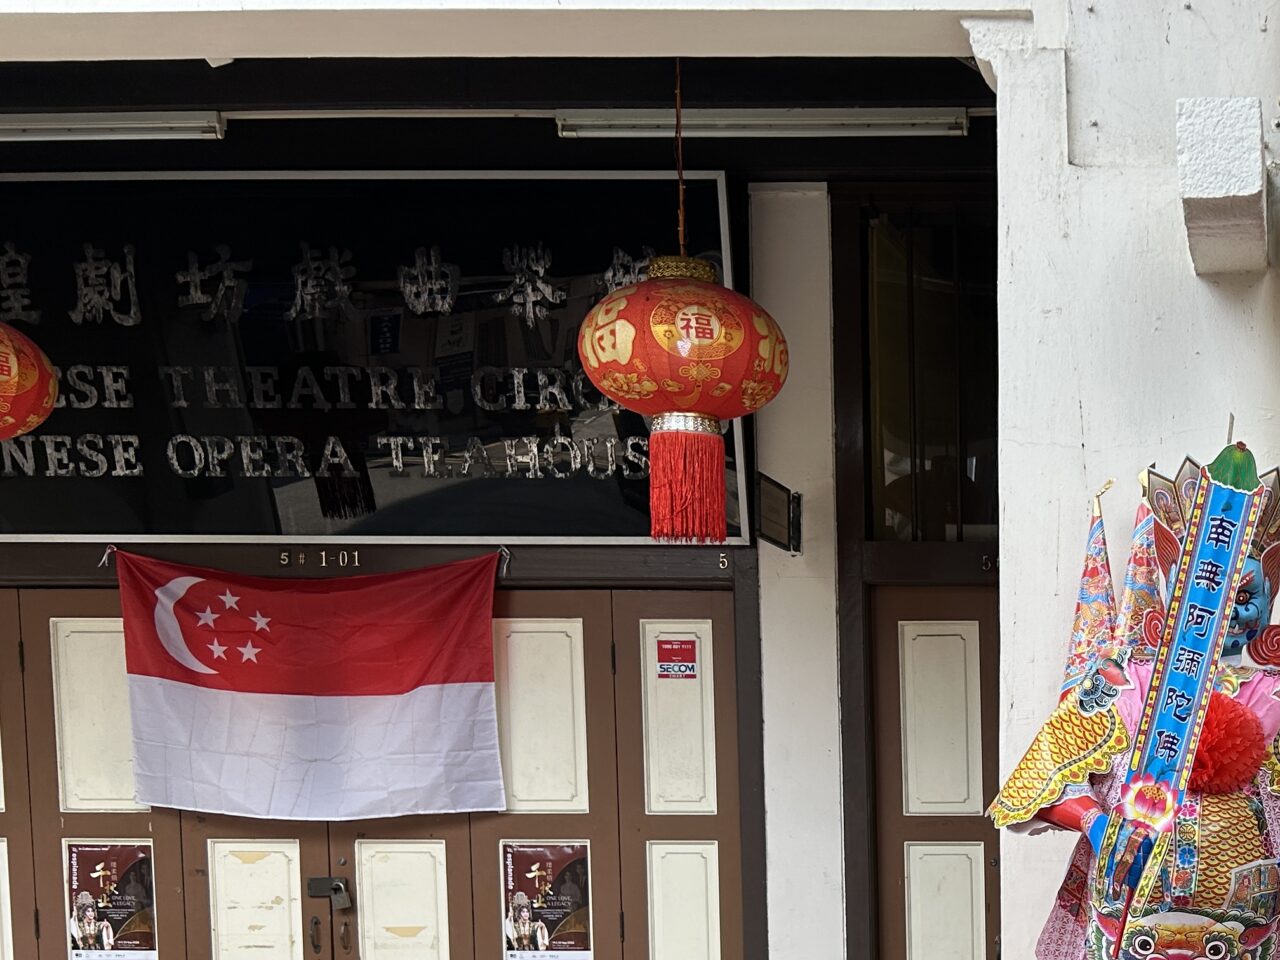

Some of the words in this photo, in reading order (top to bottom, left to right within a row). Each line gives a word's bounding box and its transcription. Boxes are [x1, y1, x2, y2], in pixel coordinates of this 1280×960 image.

[679, 312, 715, 340] 福
[160, 366, 437, 412] THEATRE
[167, 434, 361, 478] OPERA
[377, 436, 650, 480] TEAHOUS
[280, 552, 289, 565] 5
[320, 550, 360, 567] 1-01
[719, 553, 728, 568] 5
[1154, 514, 1239, 764] 南無阿彌陀佛
[660, 664, 695, 673] SECOM
